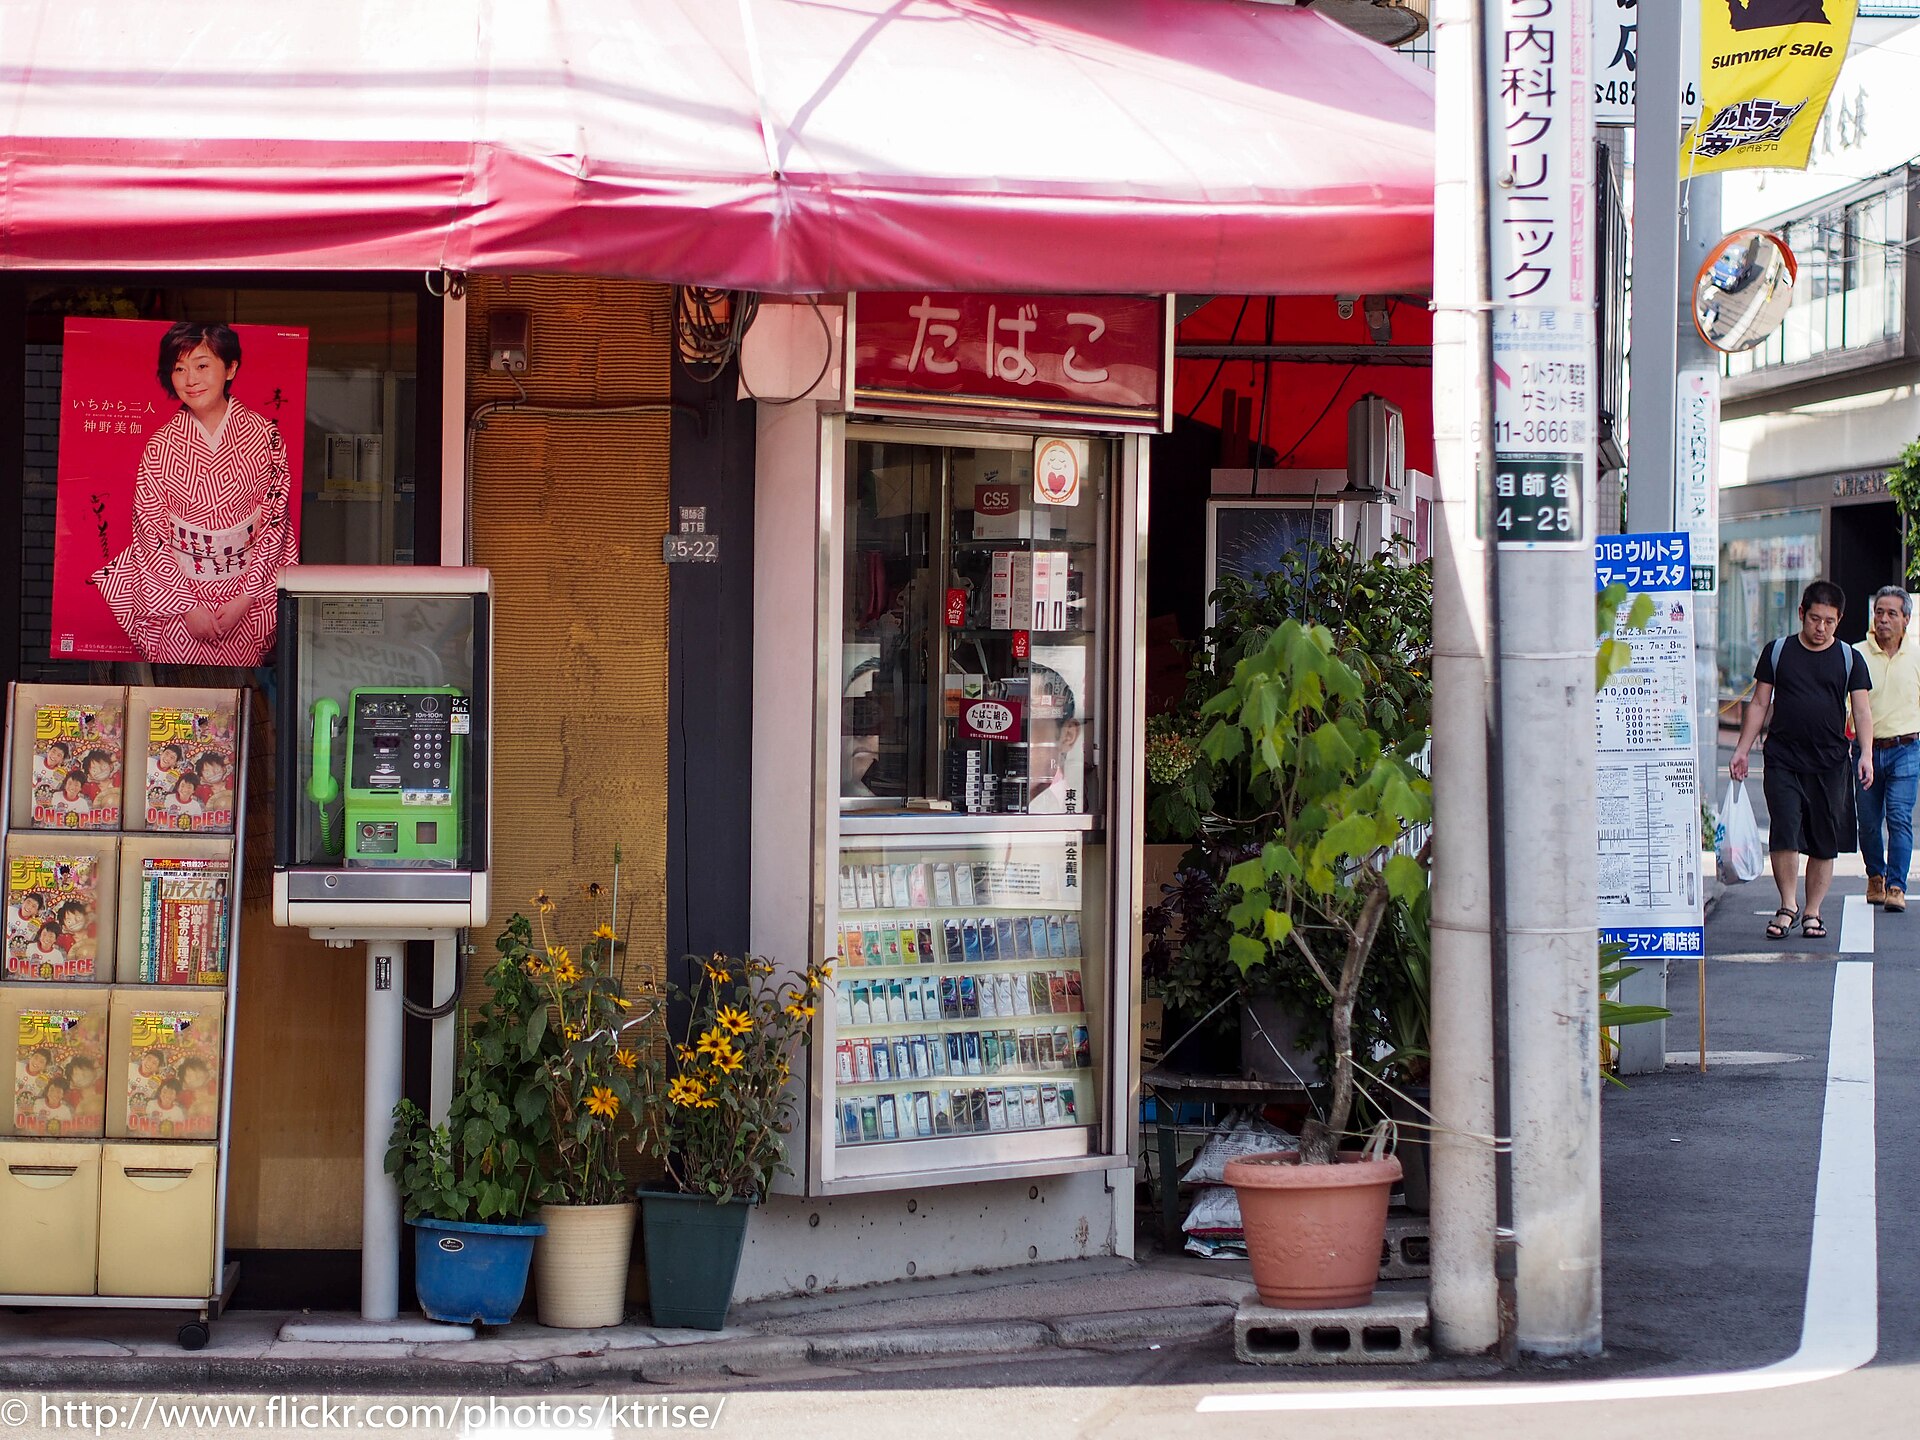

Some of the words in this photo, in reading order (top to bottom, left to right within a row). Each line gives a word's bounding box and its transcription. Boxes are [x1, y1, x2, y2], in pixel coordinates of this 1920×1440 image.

[1711, 43, 1787, 69] summer
[1789, 41, 1834, 58] sale
[908, 295, 1109, 384] たばこ
[73, 399, 156, 414] いちから二人
[83, 420, 142, 434] 神野美伽
[681, 509, 705, 520] 祖師谷
[681, 522, 705, 533] 四丁目
[1595, 564, 1686, 588] マーフェスタ
[971, 709, 1008, 721] たばこ組合
[977, 719, 1002, 730] 加入店
[34, 805, 64, 828] ONE
[79, 807, 119, 828] PIECE
[147, 809, 176, 830] ONE
[192, 809, 231, 830] PIECE
[163, 880, 210, 898] ポスト
[9, 958, 38, 978] ONE
[54, 958, 93, 978] PIECE
[16, 1113, 46, 1135] ONE
[128, 1114, 158, 1135] ONE
